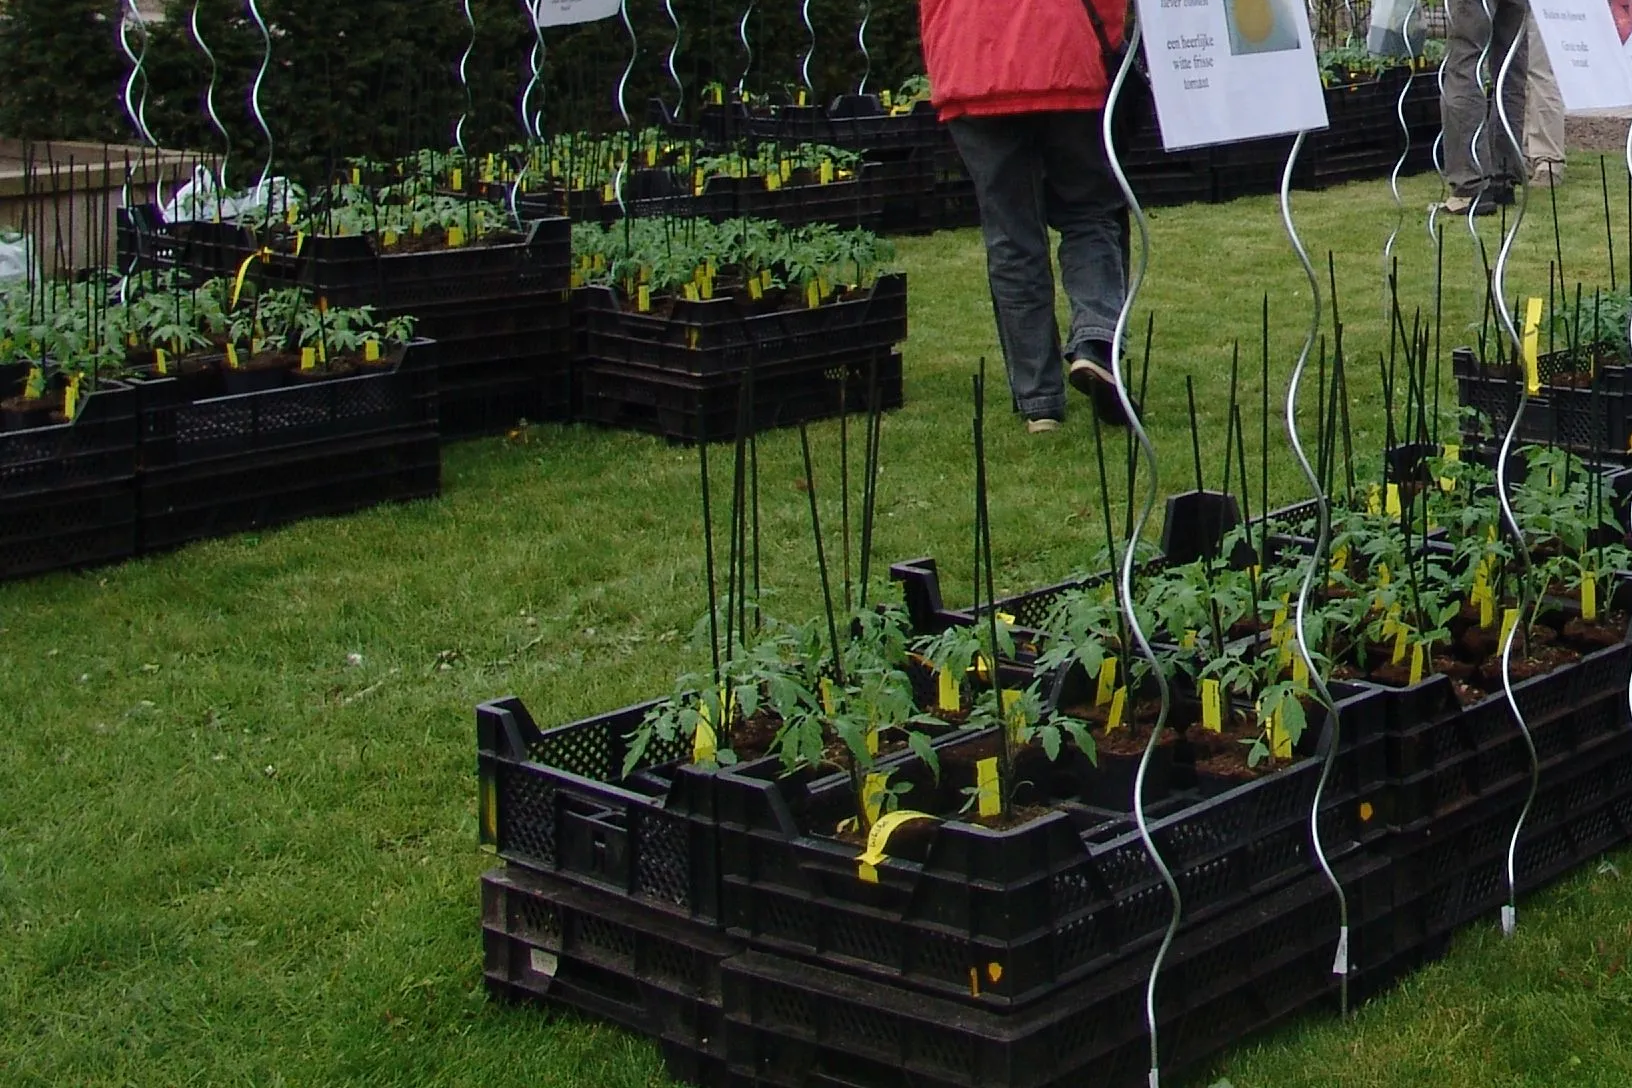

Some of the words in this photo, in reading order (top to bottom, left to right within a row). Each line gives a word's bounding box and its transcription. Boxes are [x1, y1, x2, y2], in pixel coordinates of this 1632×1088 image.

[1167, 39, 1181, 50] een
[1181, 33, 1215, 51] heerlijke
[1172, 56, 1192, 70] witte
[1193, 54, 1214, 69] frisse
